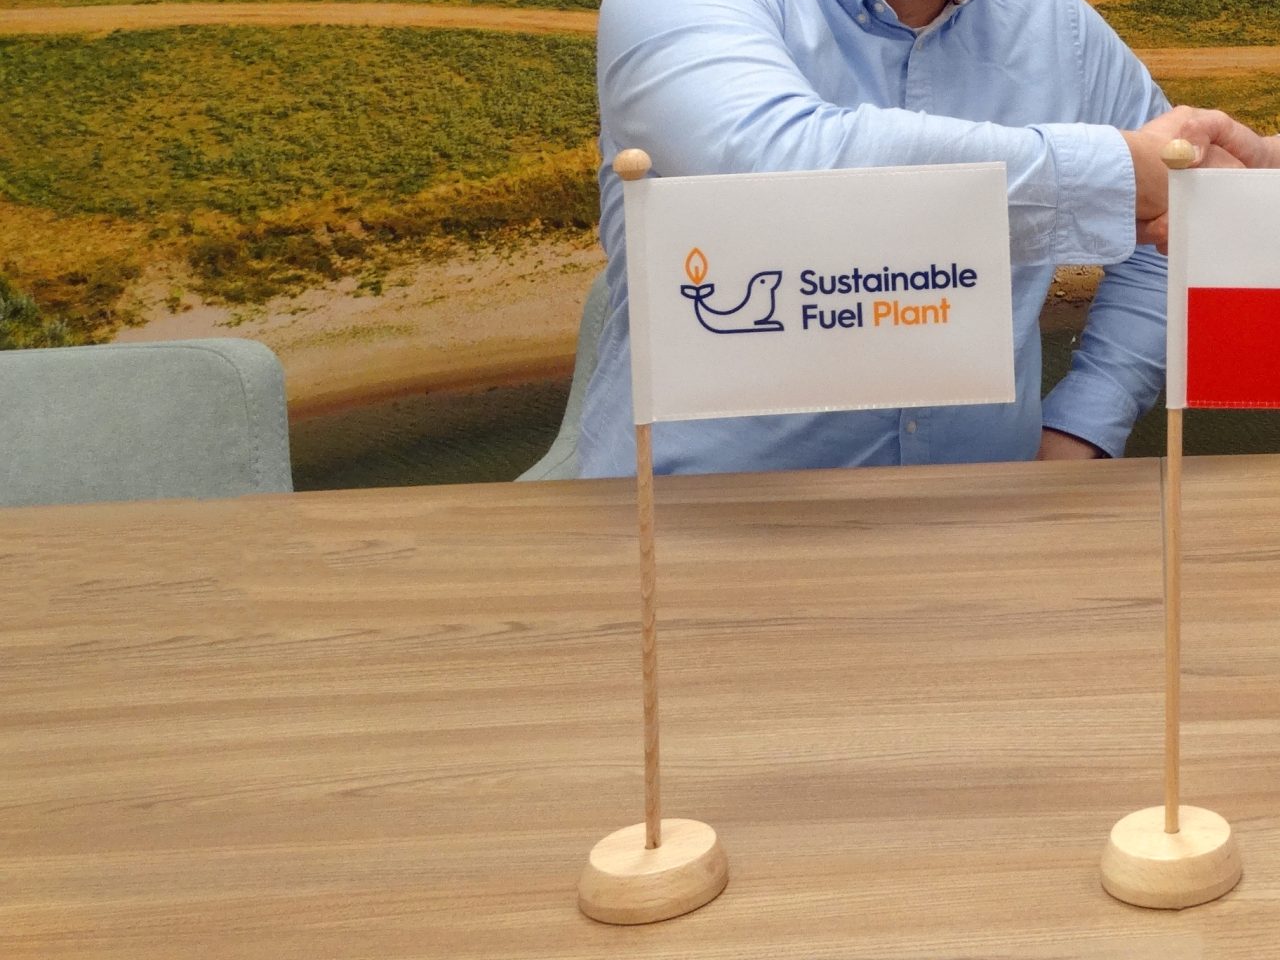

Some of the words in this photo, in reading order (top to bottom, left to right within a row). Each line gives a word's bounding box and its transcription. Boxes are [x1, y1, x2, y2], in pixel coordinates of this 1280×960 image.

[799, 262, 978, 296] Sustainable
[801, 301, 864, 330] Fuel
[872, 297, 951, 327] Plant
